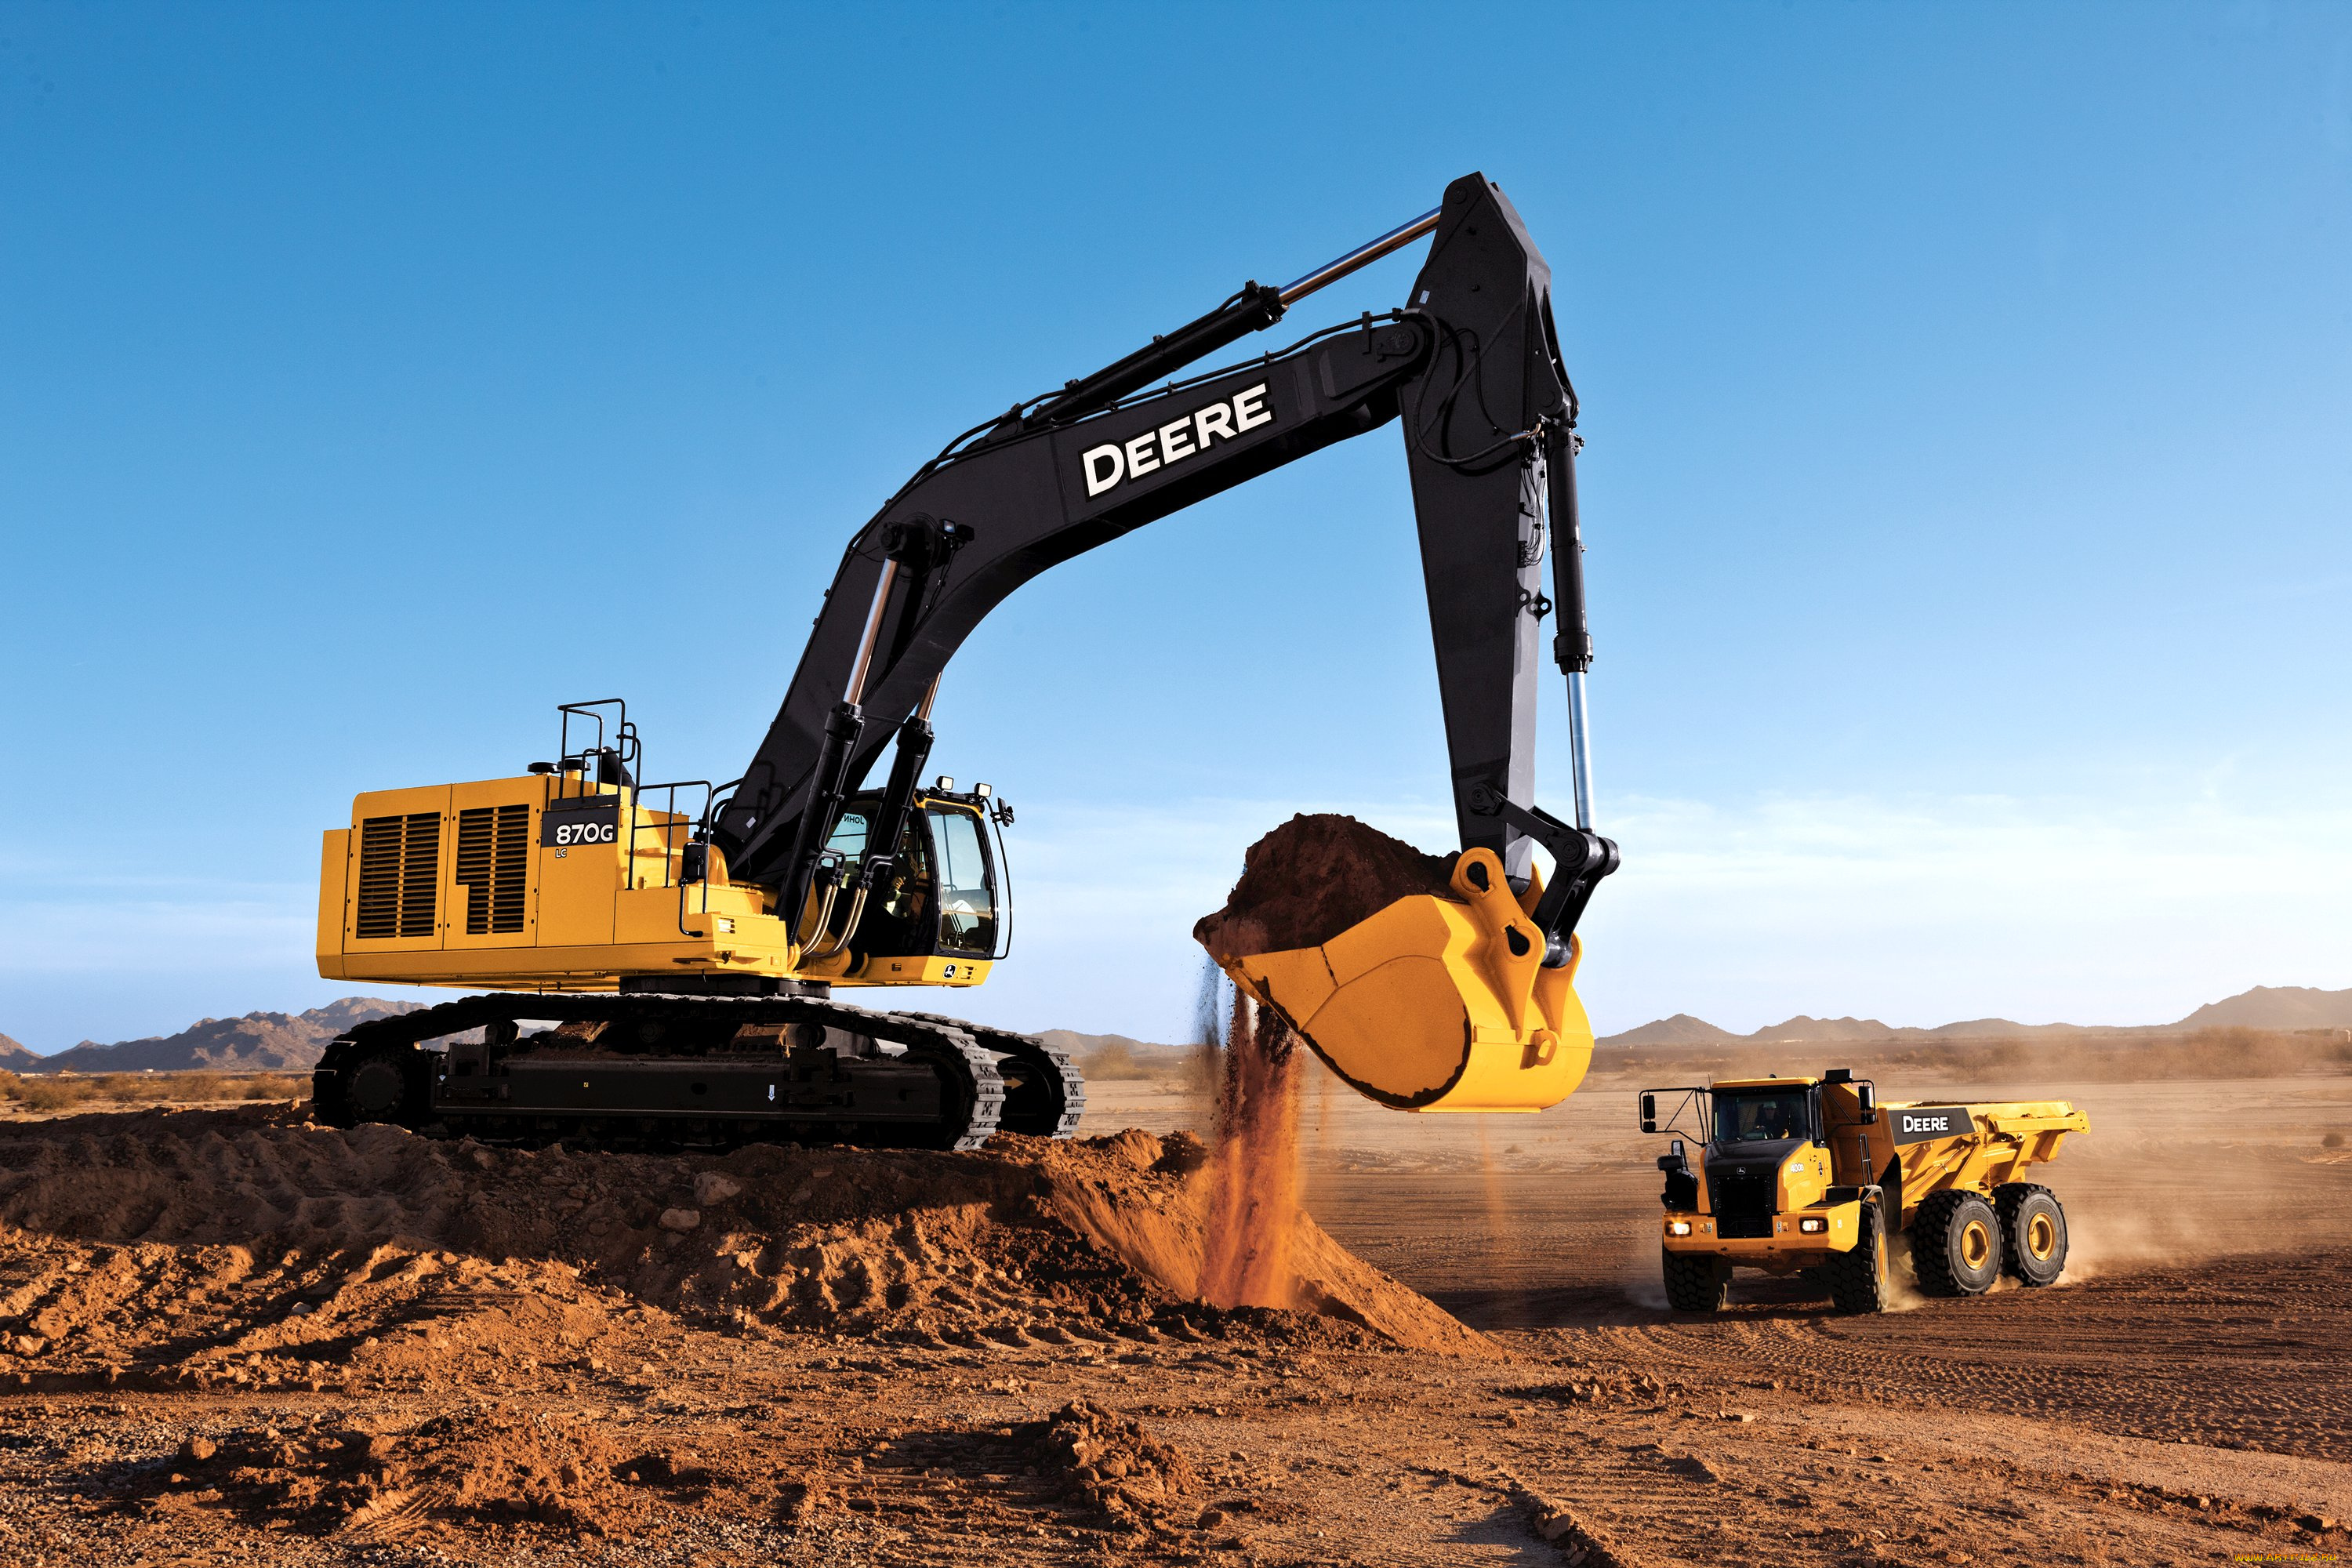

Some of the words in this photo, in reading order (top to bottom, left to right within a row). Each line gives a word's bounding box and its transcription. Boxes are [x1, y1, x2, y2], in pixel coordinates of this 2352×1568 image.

[1082, 383, 1272, 497] DEERE
[556, 822, 614, 844] 870G
[555, 849, 567, 858] LC
[1902, 1116, 1949, 1133] DEERE
